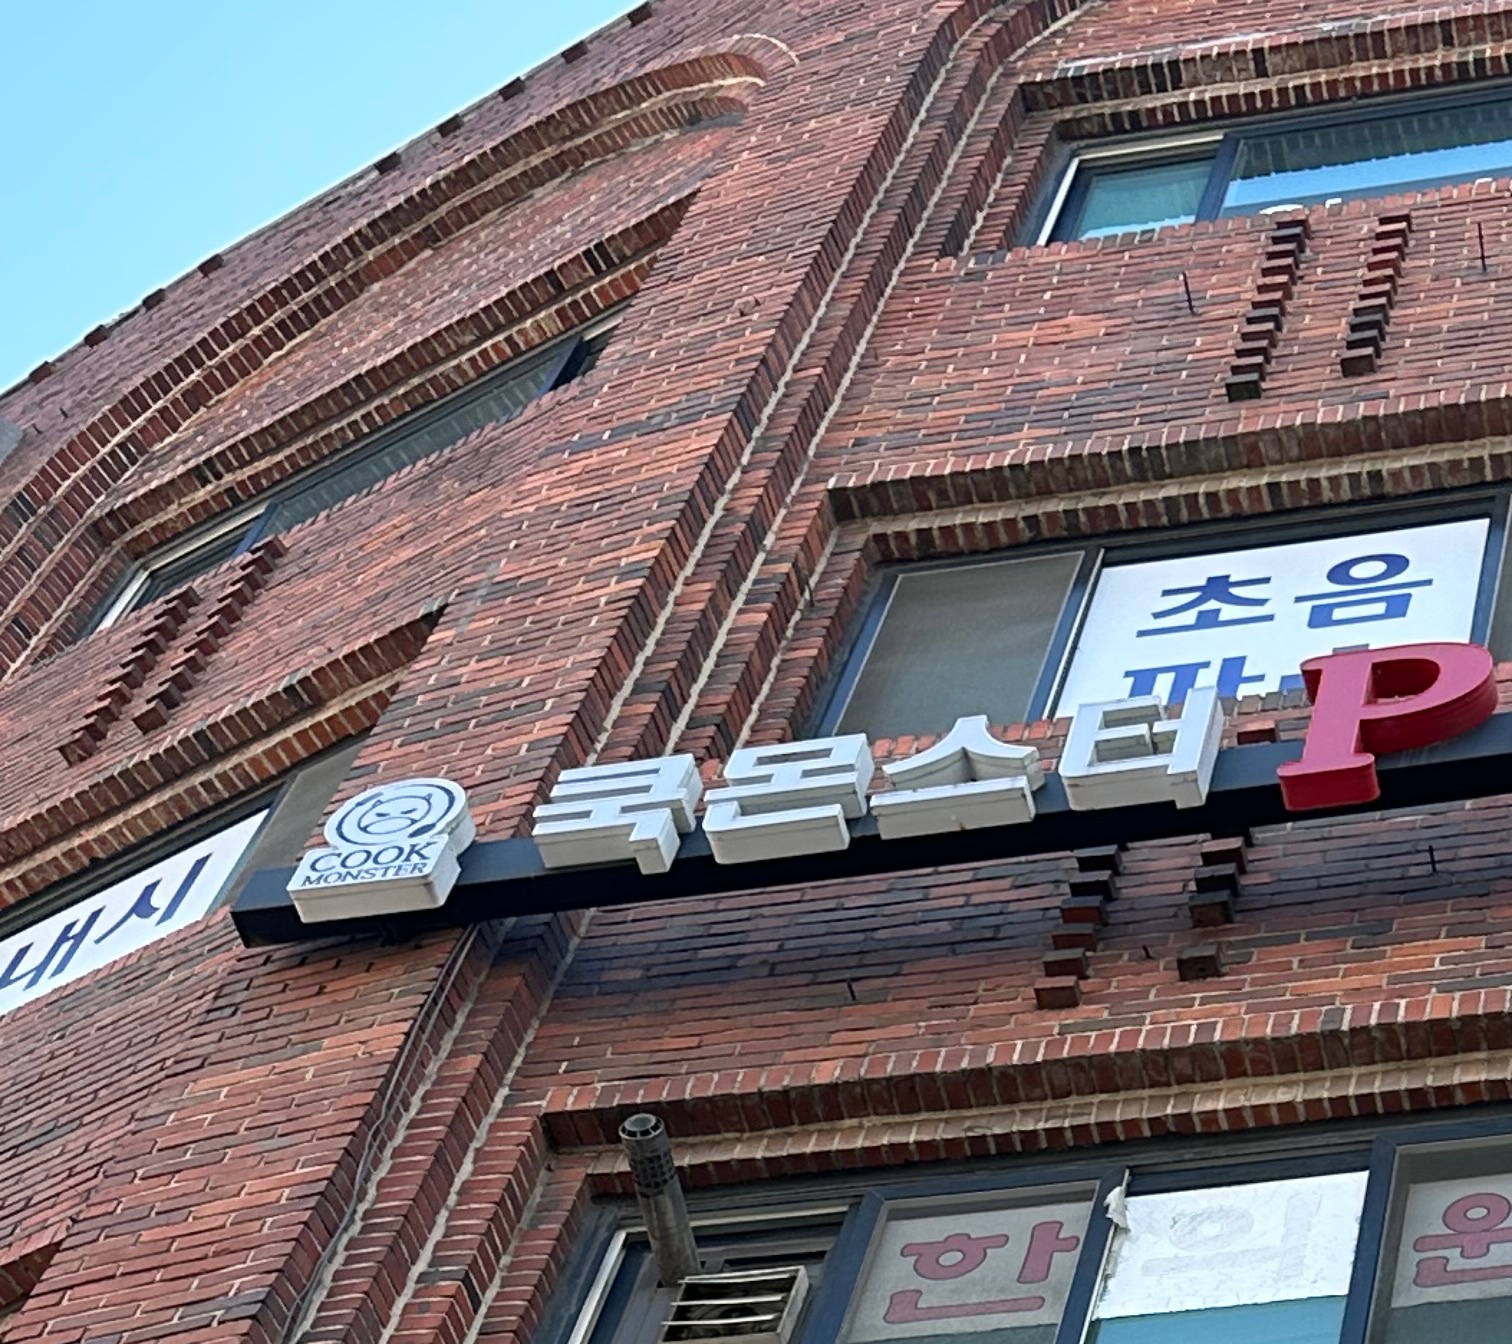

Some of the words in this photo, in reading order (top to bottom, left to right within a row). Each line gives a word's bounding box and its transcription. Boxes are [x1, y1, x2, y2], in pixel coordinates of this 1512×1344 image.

[1136, 553, 1433, 638] 초음
[532, 686, 1222, 870] 쿡몬스터
[301, 862, 429, 887] MONSTER
[309, 841, 439, 873] COOK
